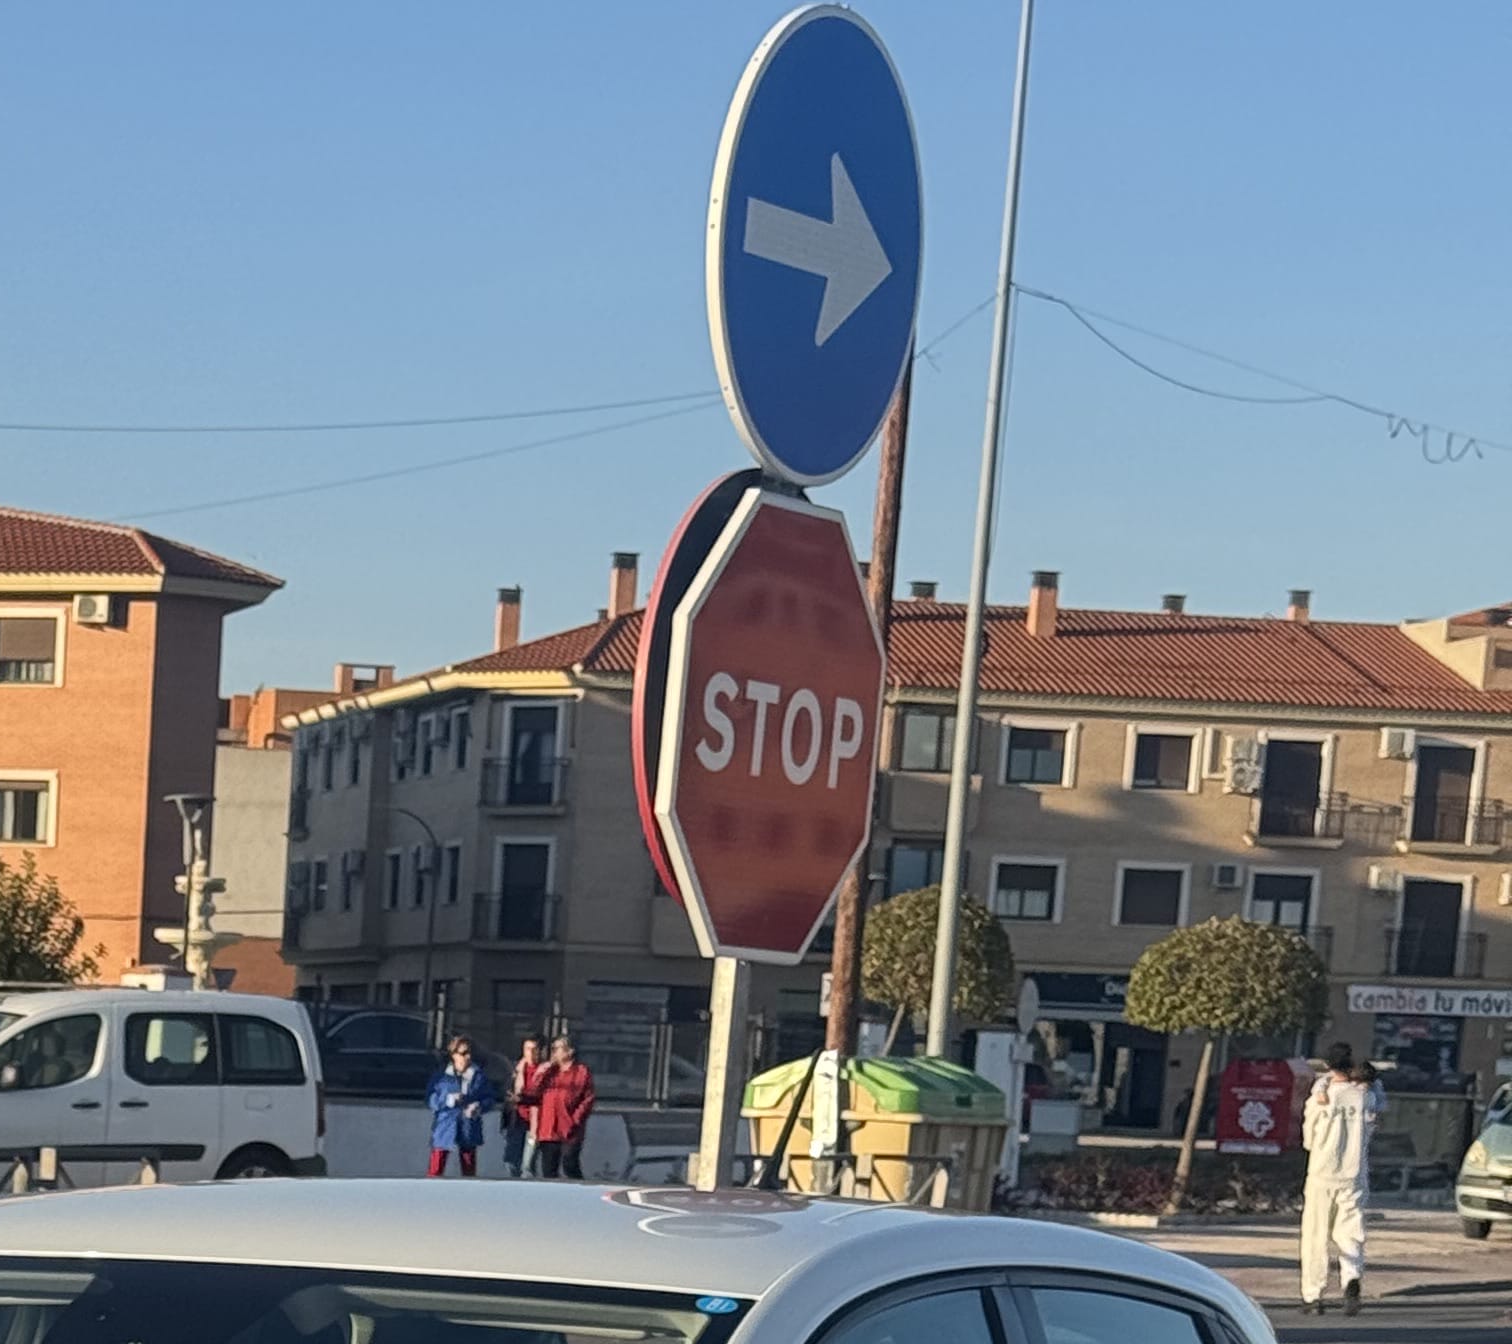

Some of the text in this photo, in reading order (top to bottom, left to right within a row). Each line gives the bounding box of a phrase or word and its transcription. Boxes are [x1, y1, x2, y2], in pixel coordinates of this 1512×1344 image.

[695, 671, 864, 789] STOP
[1353, 990, 1427, 1012] cambia
[1434, 991, 1454, 1013] tu
